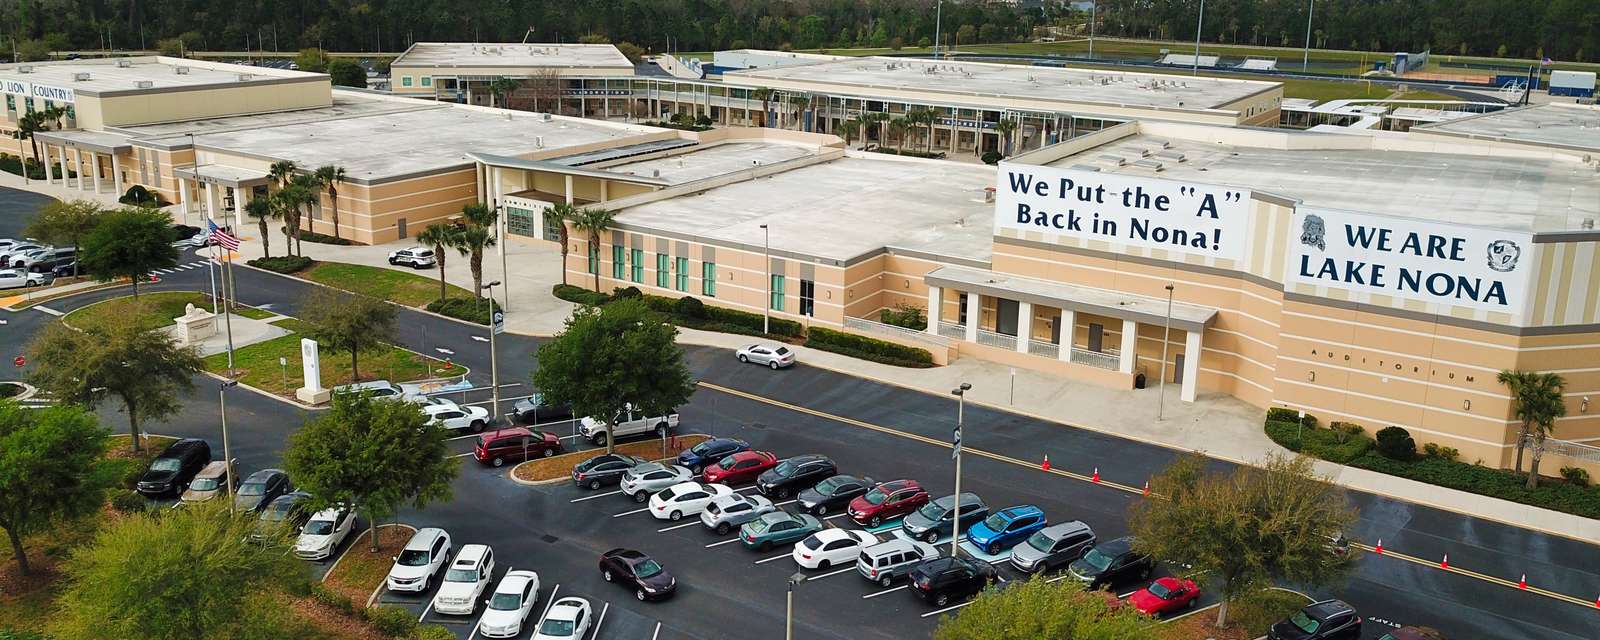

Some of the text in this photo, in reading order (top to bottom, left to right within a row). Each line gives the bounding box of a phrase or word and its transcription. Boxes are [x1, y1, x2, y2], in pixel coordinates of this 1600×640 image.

[7, 81, 25, 94] LION
[33, 85, 67, 100] COUNTRY
[1008, 171, 1049, 197] We
[1059, 178, 1106, 204] Put
[1122, 186, 1170, 212] the
[1016, 203, 1222, 251] Back in Nona!
[1344, 223, 1393, 252] WE
[1399, 231, 1466, 262] ARE
[1299, 254, 1509, 306] LAKE NONA
[1310, 348, 1475, 384] AUDITORIUM
